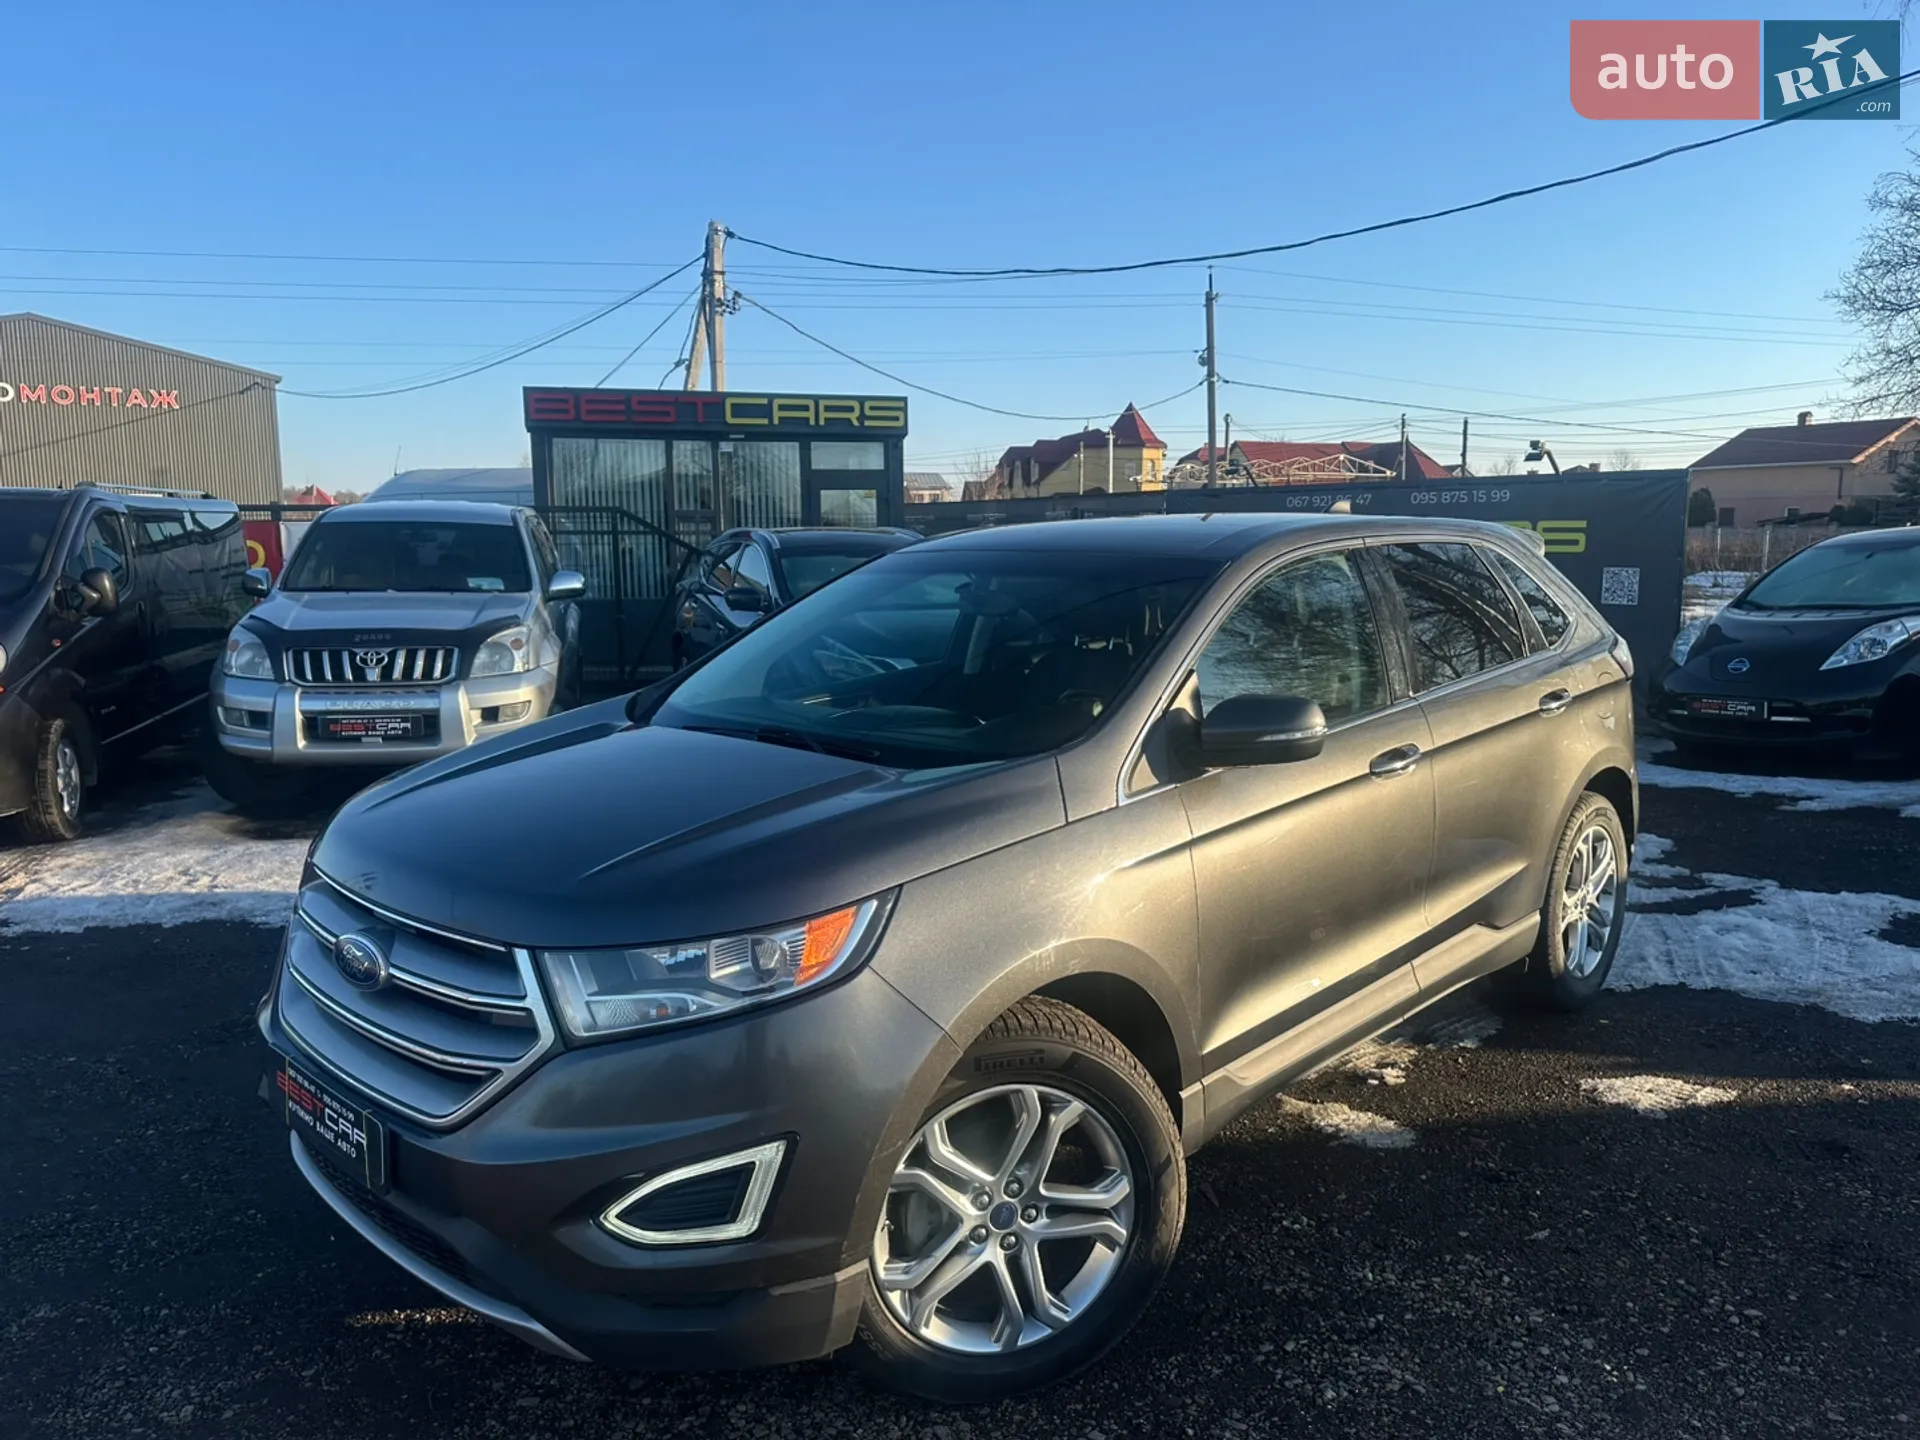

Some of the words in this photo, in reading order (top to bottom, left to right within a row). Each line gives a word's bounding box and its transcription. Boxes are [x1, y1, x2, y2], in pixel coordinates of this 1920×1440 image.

[1286, 496, 1309, 507] 067
[1355, 493, 1372, 505] 47
[1410, 492, 1438, 504] 095
[1441, 490, 1468, 503] 875
[1471, 489, 1487, 502] 15
[1490, 489, 1511, 502] 99
